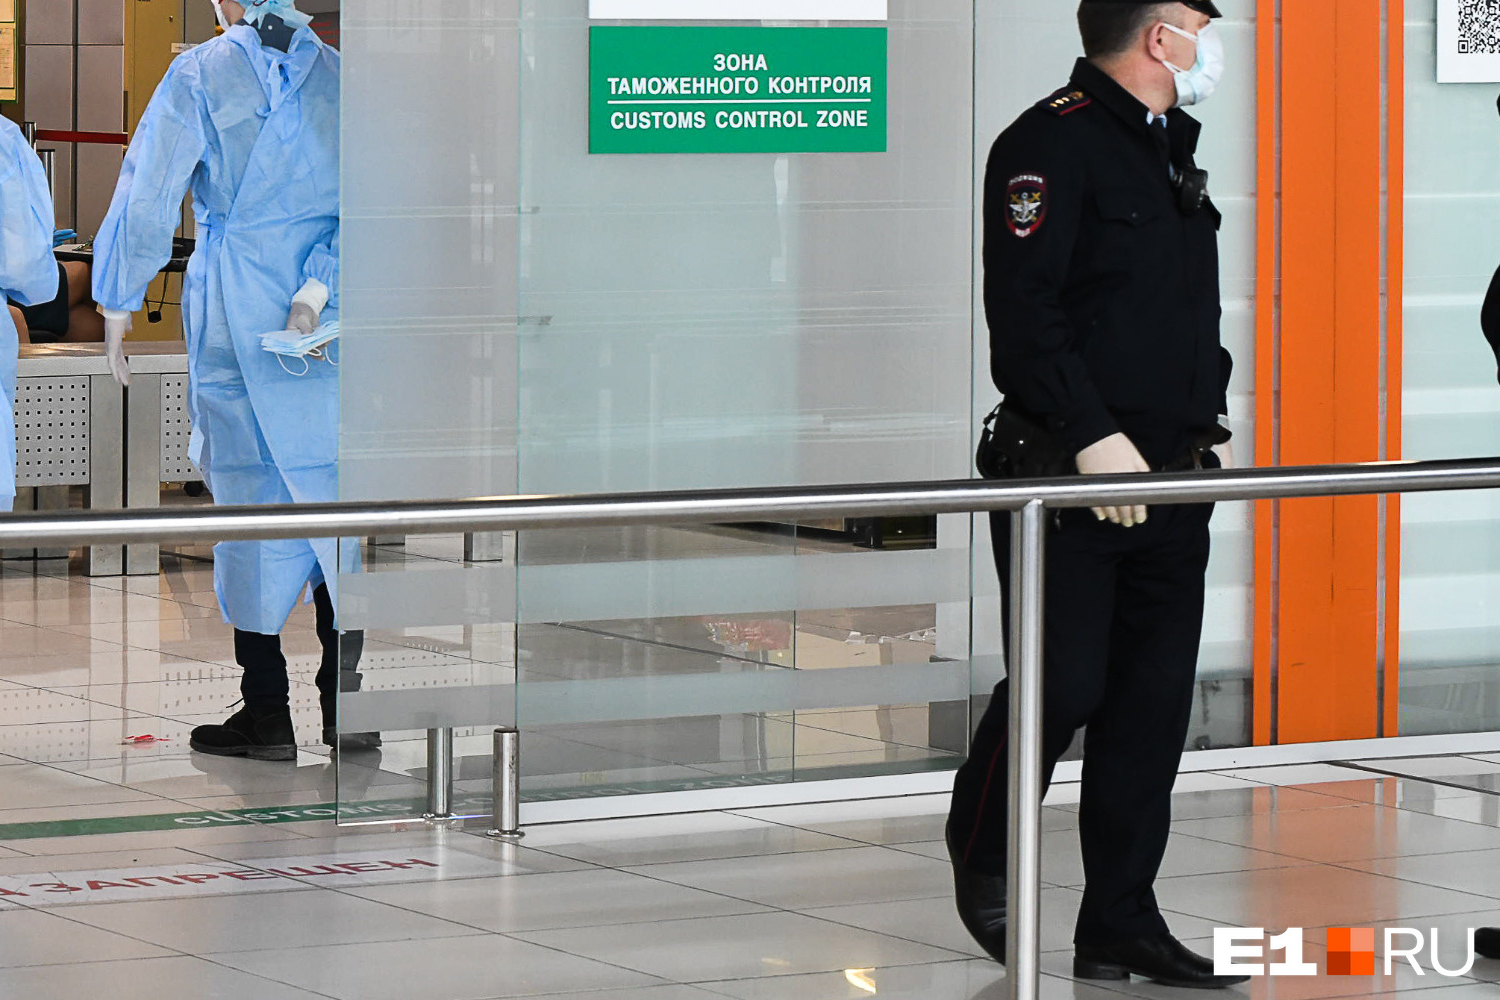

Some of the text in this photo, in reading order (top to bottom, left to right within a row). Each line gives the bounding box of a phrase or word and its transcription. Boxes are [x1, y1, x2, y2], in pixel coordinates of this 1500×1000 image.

[713, 53, 769, 72] ЗОНА
[607, 76, 872, 95] ТАМОЖЕННОГО КОНТРОЛЯ
[610, 109, 868, 130] CUSTOMS CONTROL ZONE
[173, 802, 413, 825] CUSTOMS
[28, 857, 441, 894] ЗАПРЕЩЕН
